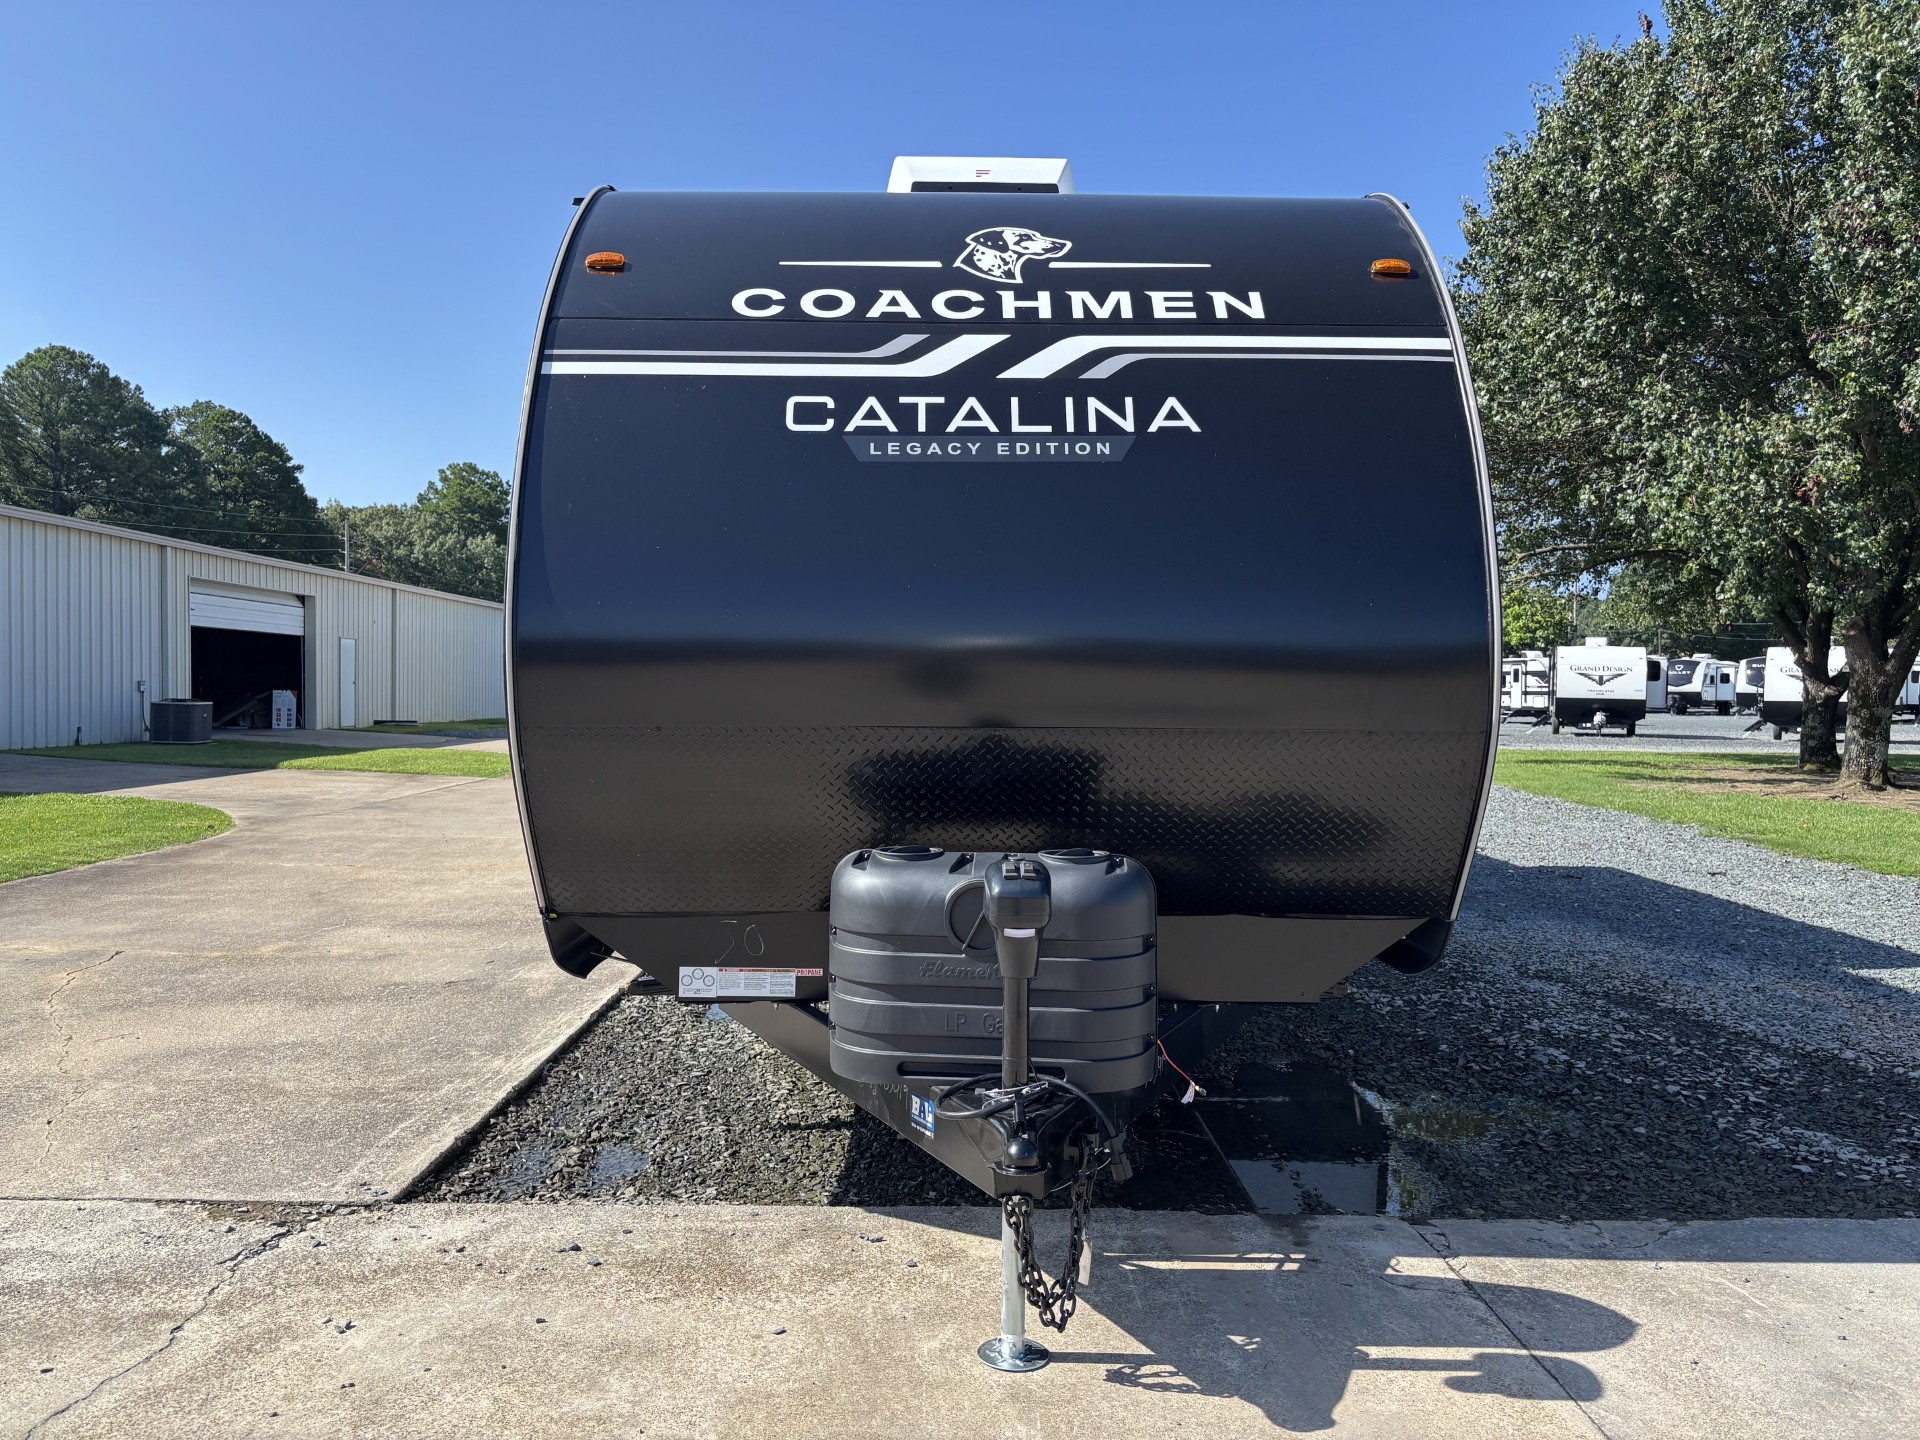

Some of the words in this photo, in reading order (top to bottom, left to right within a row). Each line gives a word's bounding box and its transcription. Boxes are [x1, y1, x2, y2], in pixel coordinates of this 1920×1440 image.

[731, 287, 1267, 320] COACHMEN
[785, 395, 1202, 433] CATALINA
[869, 442, 982, 456] LEGACY
[997, 442, 1112, 456] EDITION
[1602, 665, 1633, 673] DESIGN
[796, 968, 822, 976] PROPANE
[945, 1011, 967, 1032] LP
[982, 1012, 1003, 1034] Ga
